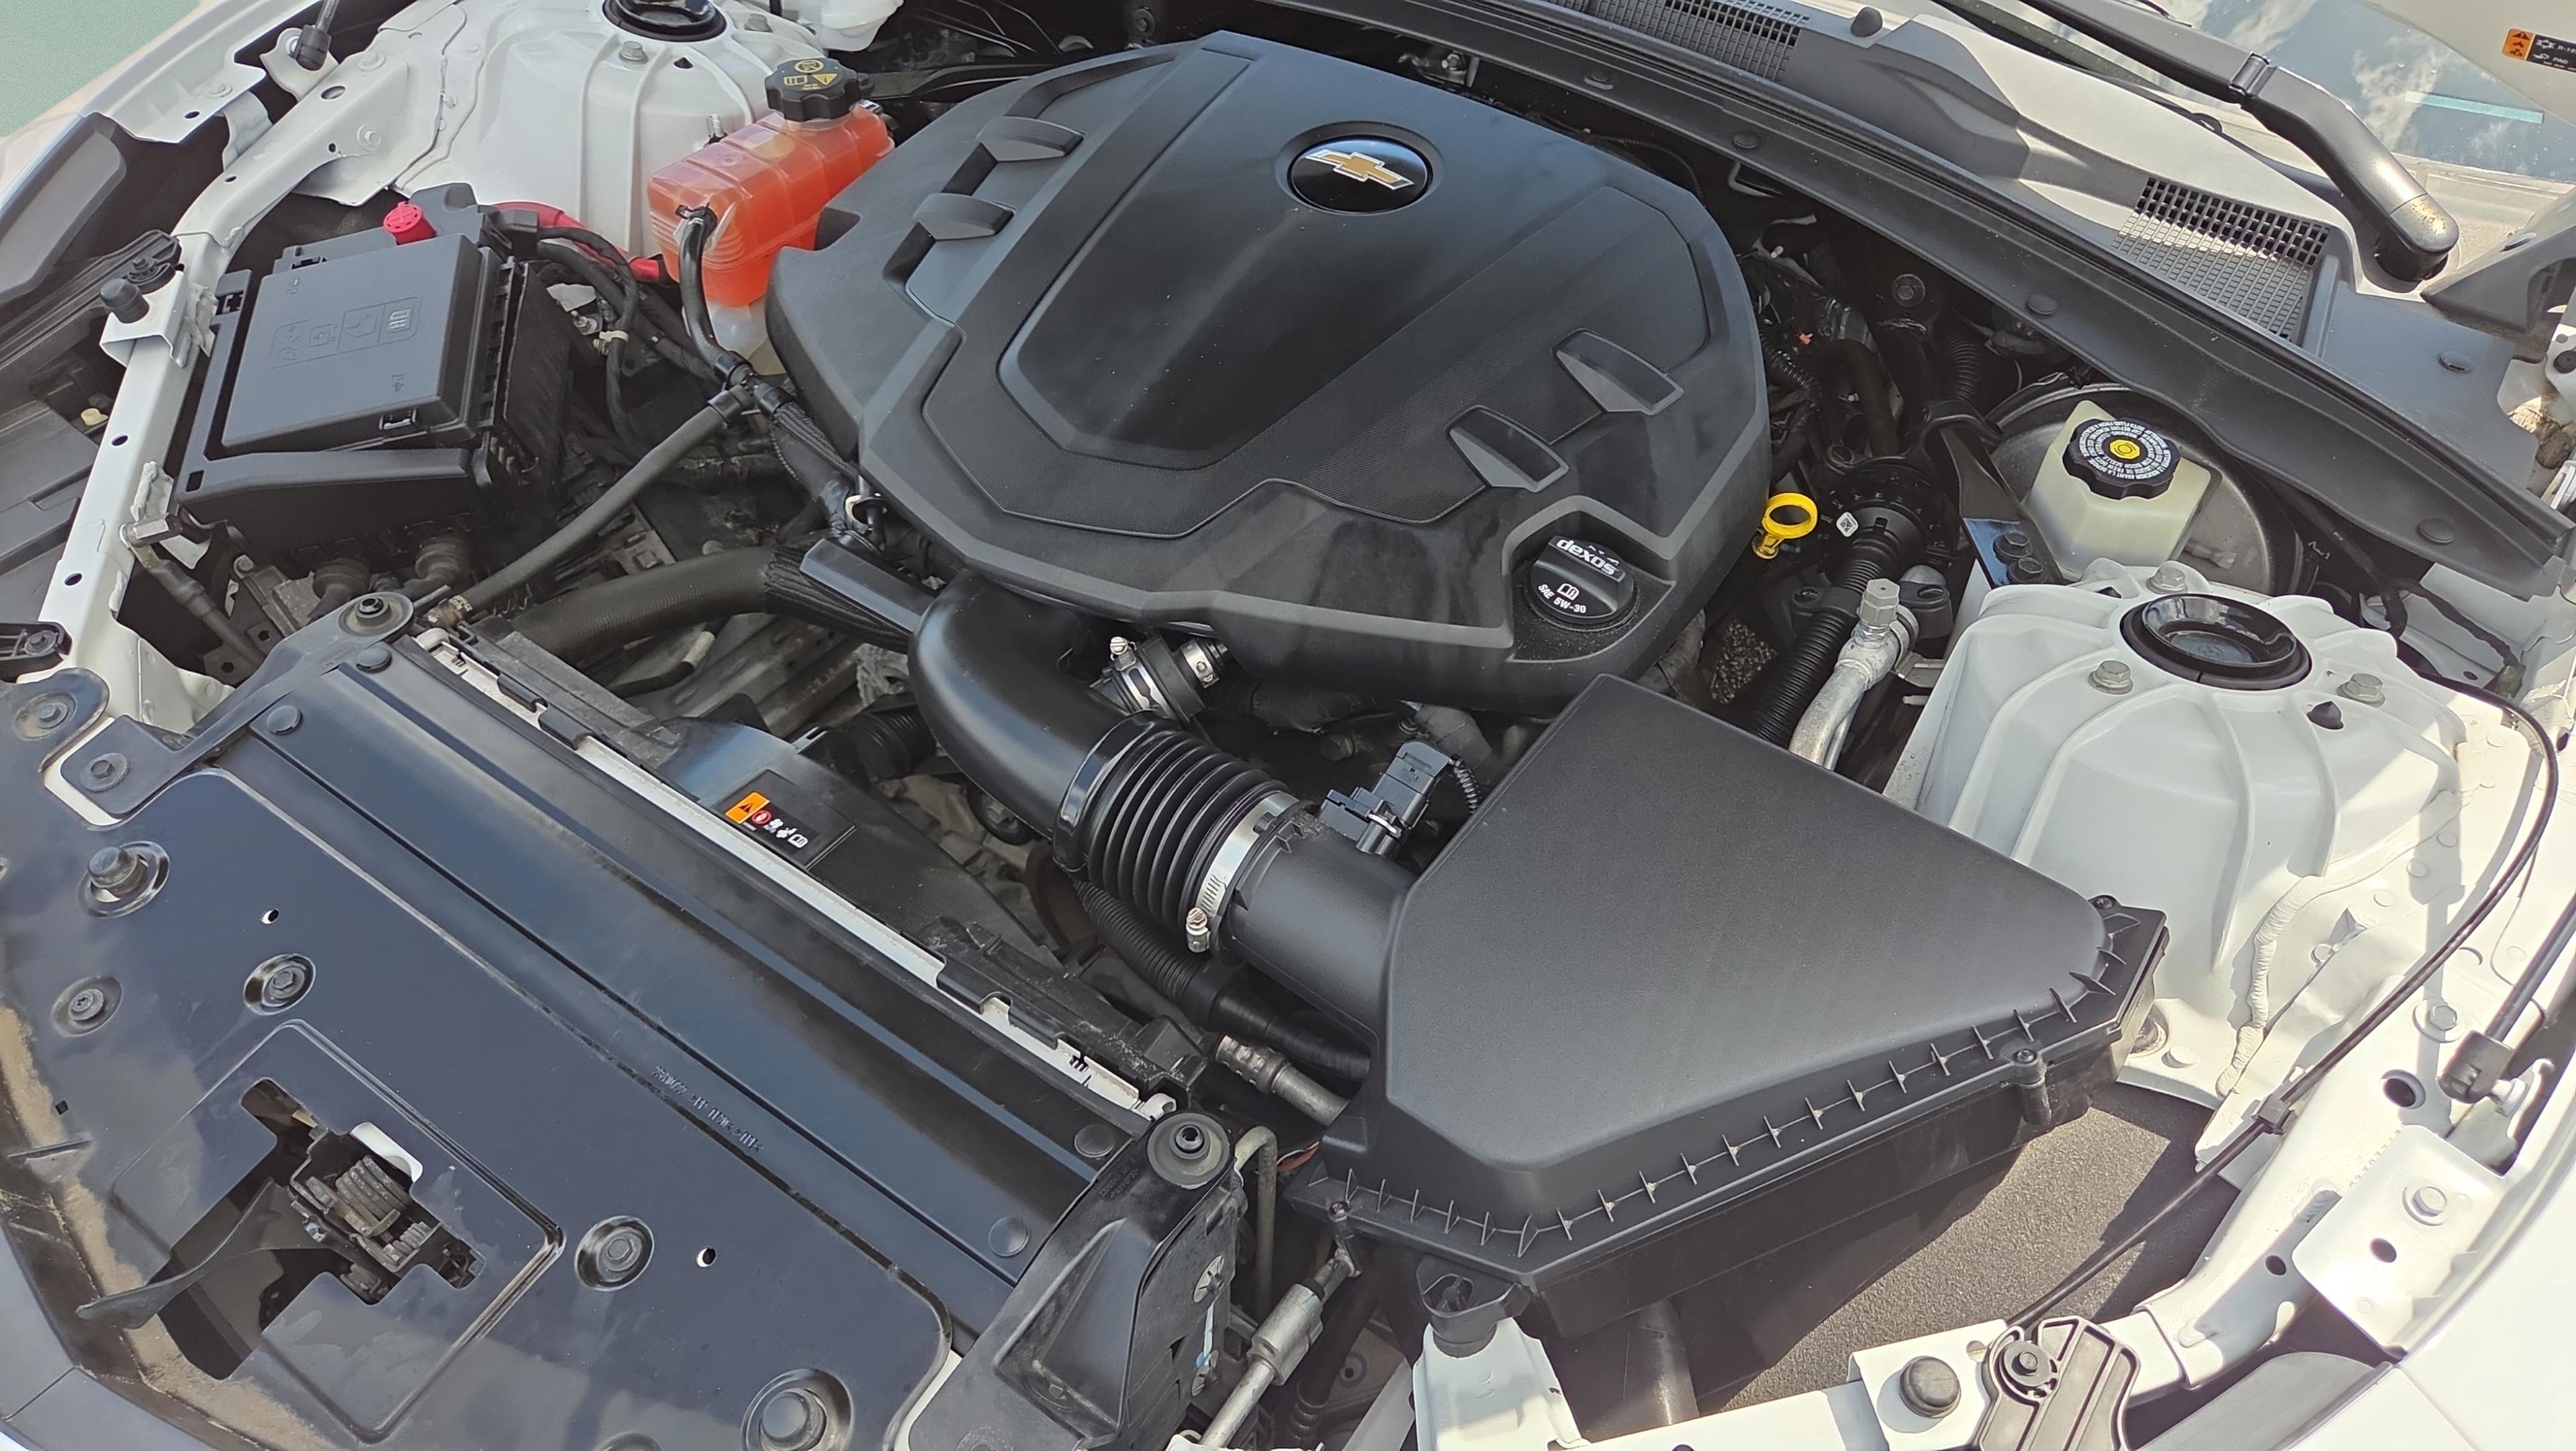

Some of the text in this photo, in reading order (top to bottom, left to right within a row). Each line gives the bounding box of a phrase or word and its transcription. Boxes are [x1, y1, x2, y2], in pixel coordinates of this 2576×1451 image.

[1556, 539, 1616, 575] dexos
[1538, 584, 1587, 613] SAE 5W-30
